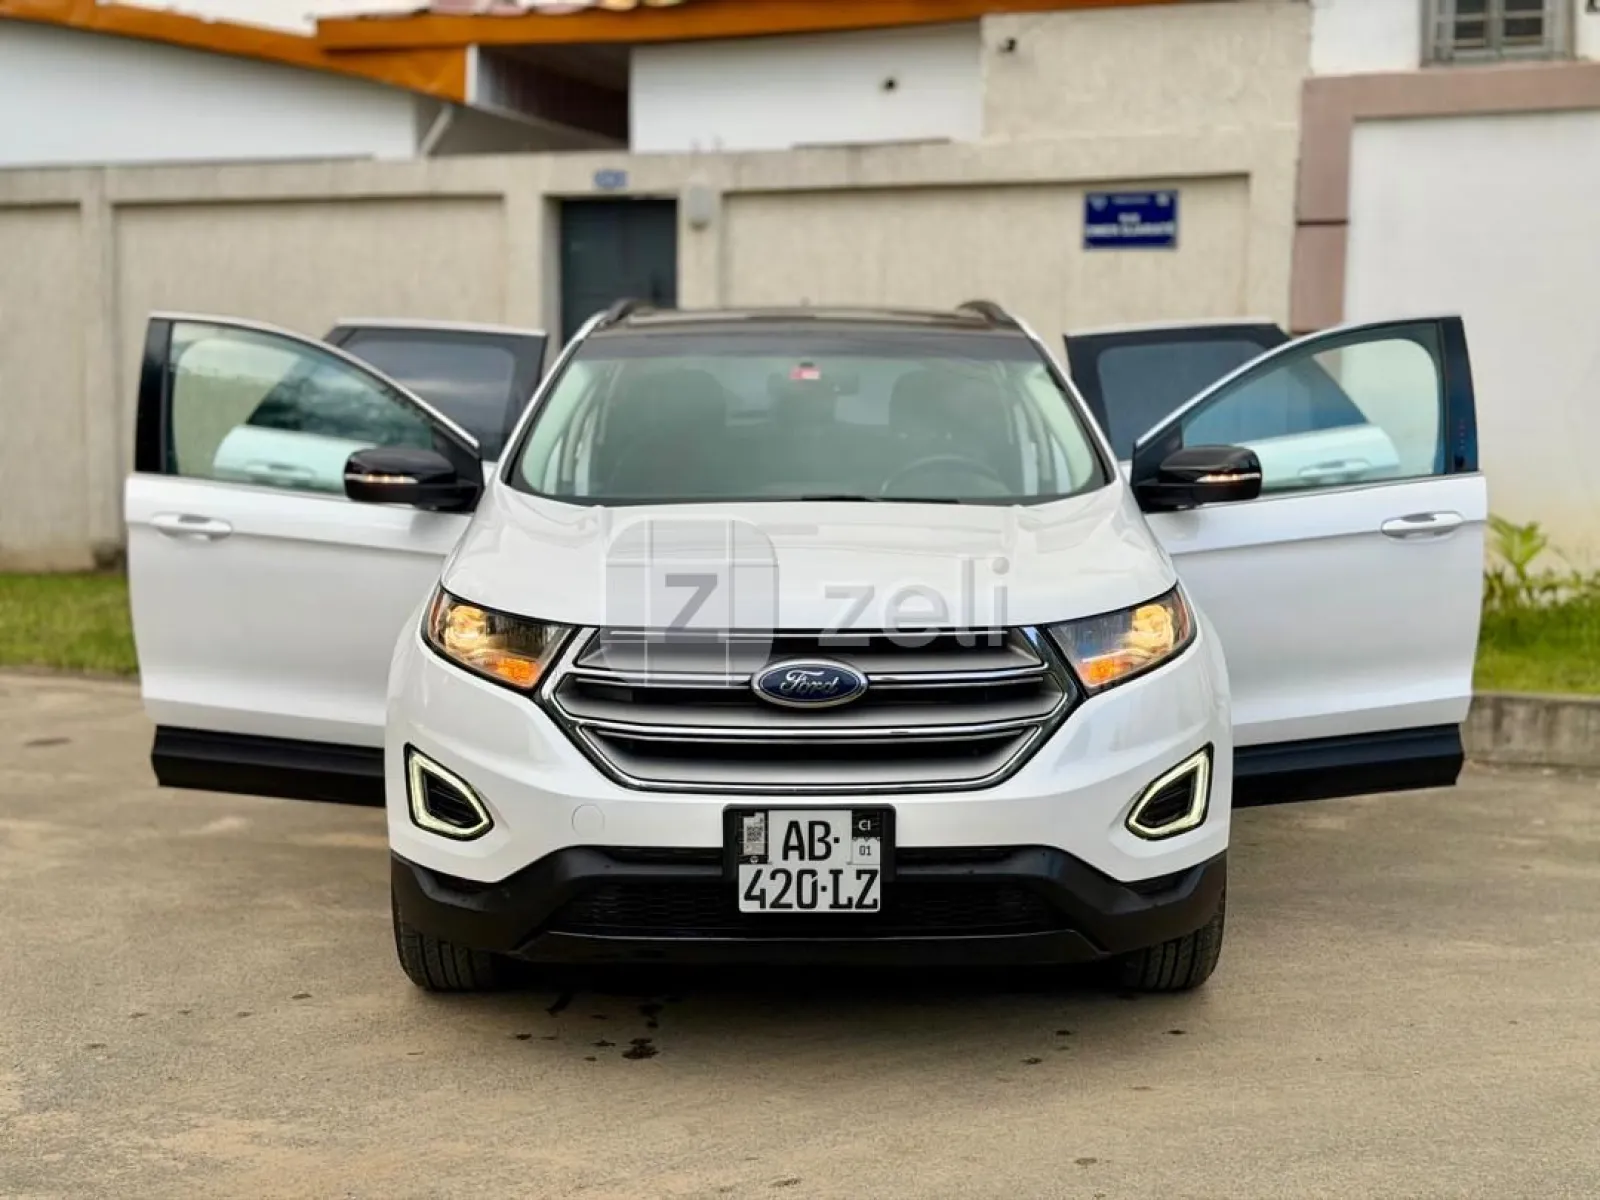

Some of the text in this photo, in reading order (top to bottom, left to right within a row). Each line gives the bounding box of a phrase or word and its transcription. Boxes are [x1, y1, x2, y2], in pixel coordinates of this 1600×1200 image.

[780, 670, 838, 693] Ford
[858, 820, 872, 831] CI
[858, 845, 872, 856] 01
